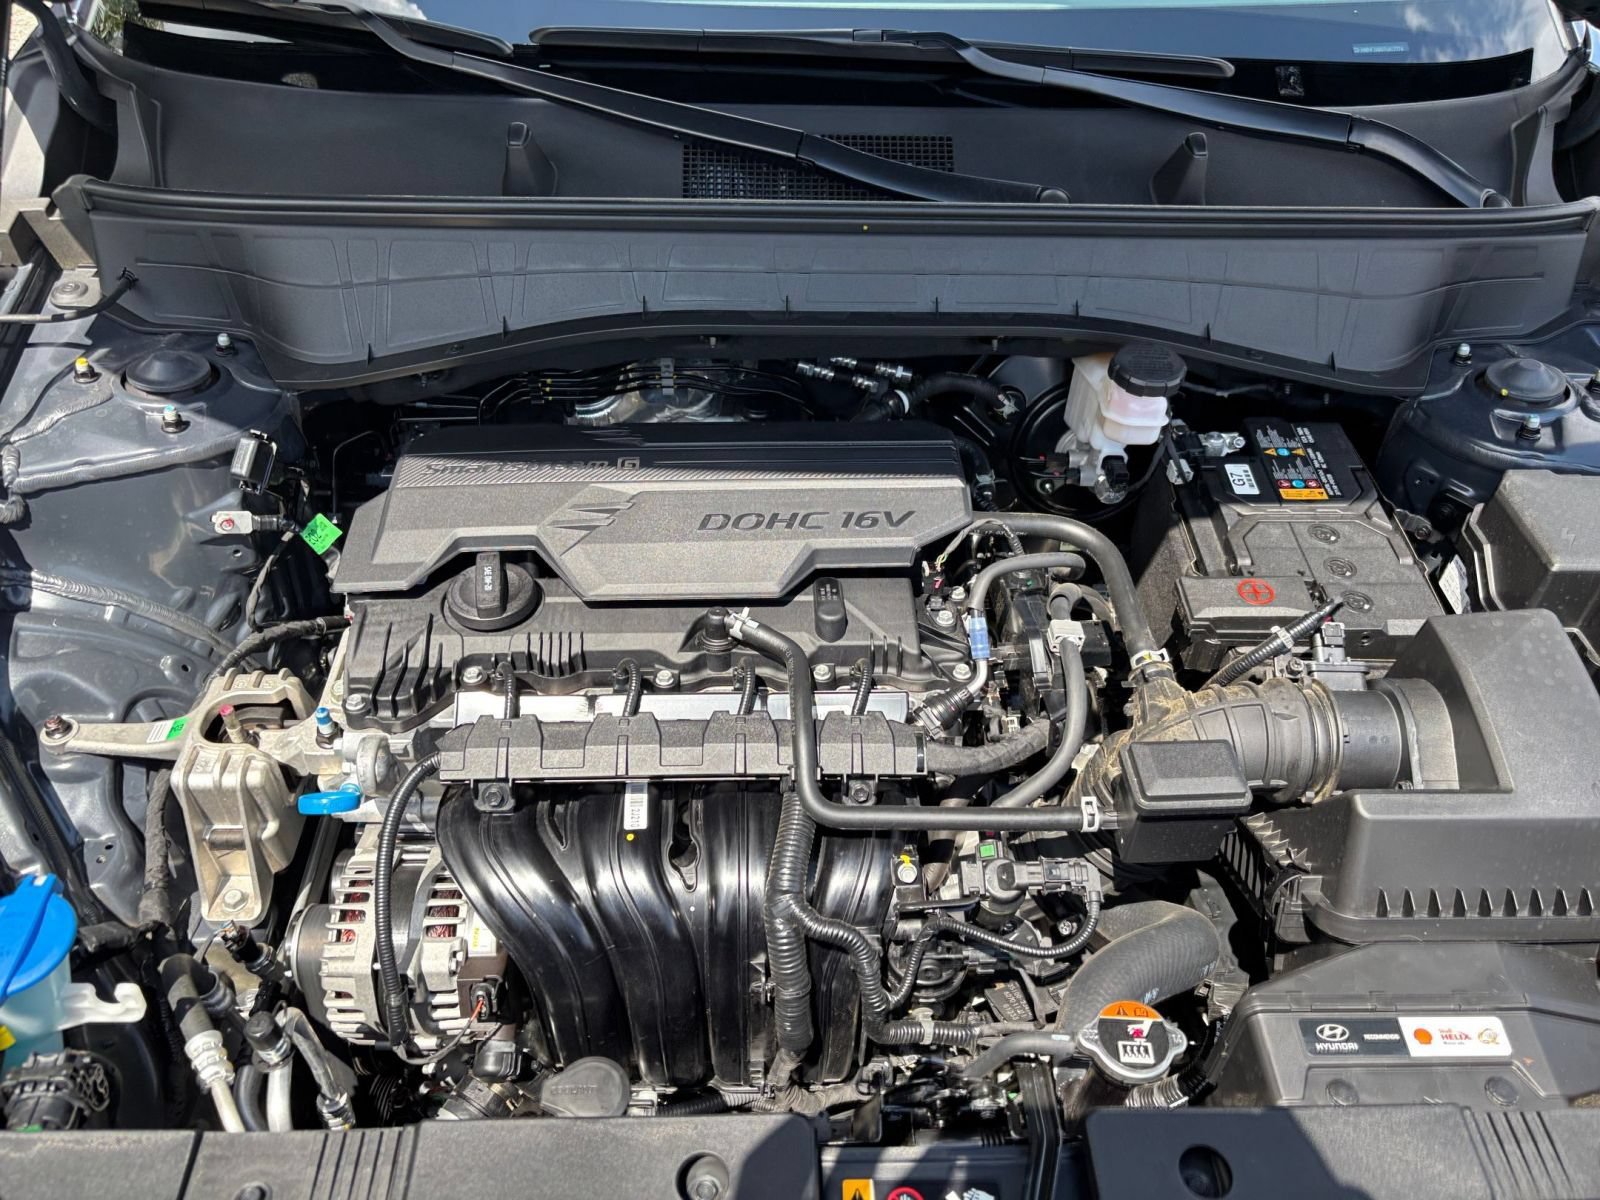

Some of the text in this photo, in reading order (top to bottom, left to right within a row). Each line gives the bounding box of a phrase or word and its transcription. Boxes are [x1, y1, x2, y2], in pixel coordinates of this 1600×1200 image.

[1229, 472, 1246, 487] G7
[697, 510, 916, 531] DOHC 16V
[1315, 1042, 1359, 1052] HYUNDAI
